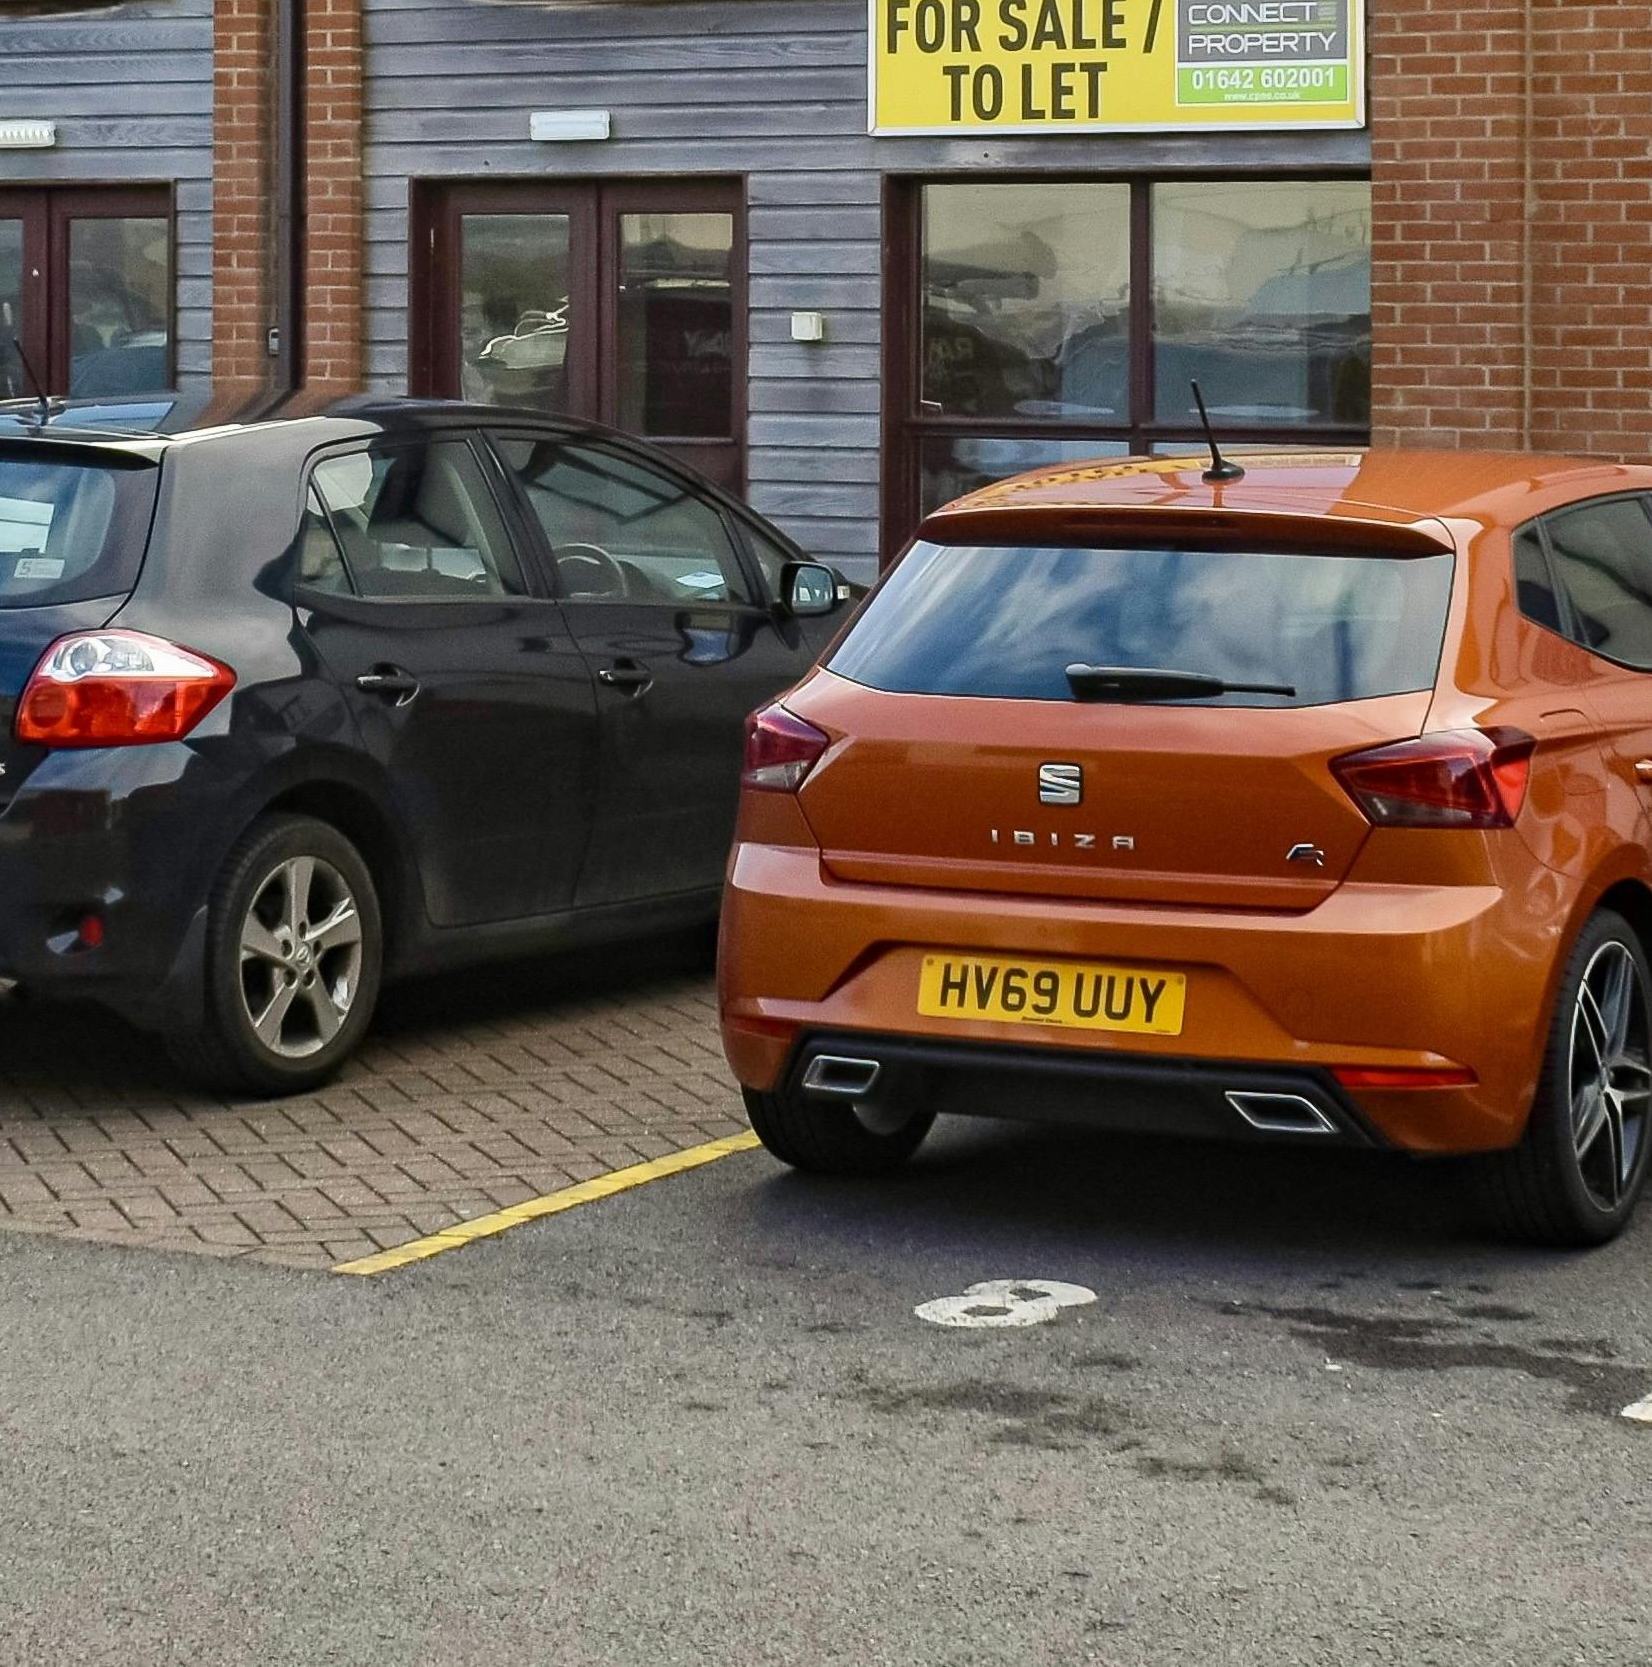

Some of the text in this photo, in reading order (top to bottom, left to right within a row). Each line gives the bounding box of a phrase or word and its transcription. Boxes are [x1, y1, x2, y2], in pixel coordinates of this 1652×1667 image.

[1188, 1, 1318, 24] CONNECT
[1188, 31, 1337, 55] PROPERTY
[1192, 67, 1334, 90] 01642 602001
[942, 61, 1108, 122] TO LET
[991, 829, 1134, 850] IBIZA
[939, 963, 1167, 1024] HV69 UUY
